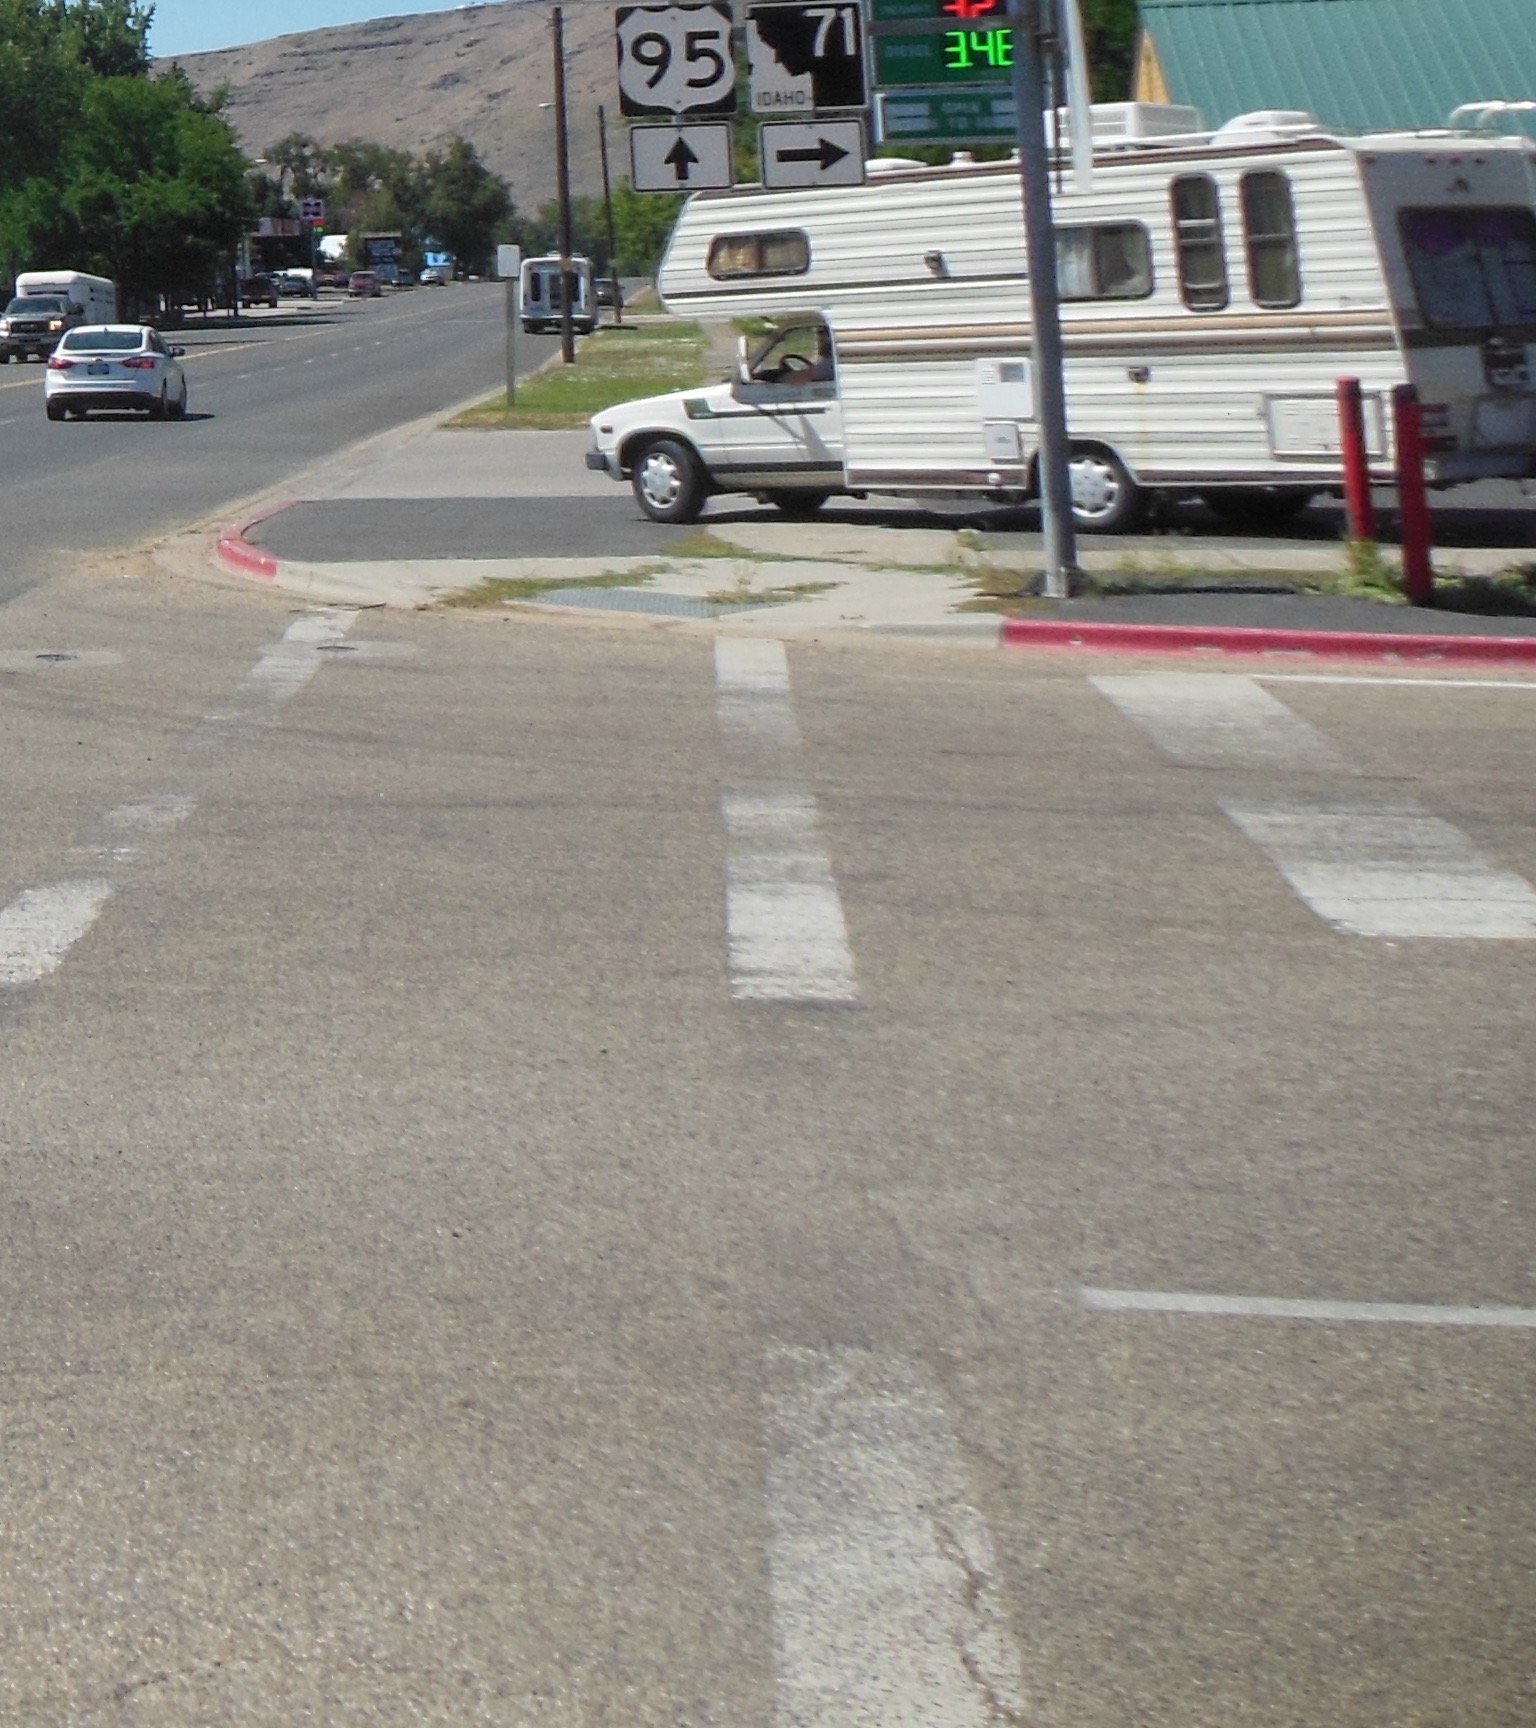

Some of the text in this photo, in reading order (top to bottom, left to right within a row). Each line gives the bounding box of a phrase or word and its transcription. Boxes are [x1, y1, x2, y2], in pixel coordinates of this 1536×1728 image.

[803, 7, 856, 58] 71
[631, 30, 726, 89] 95
[757, 90, 806, 106] IDAHO
